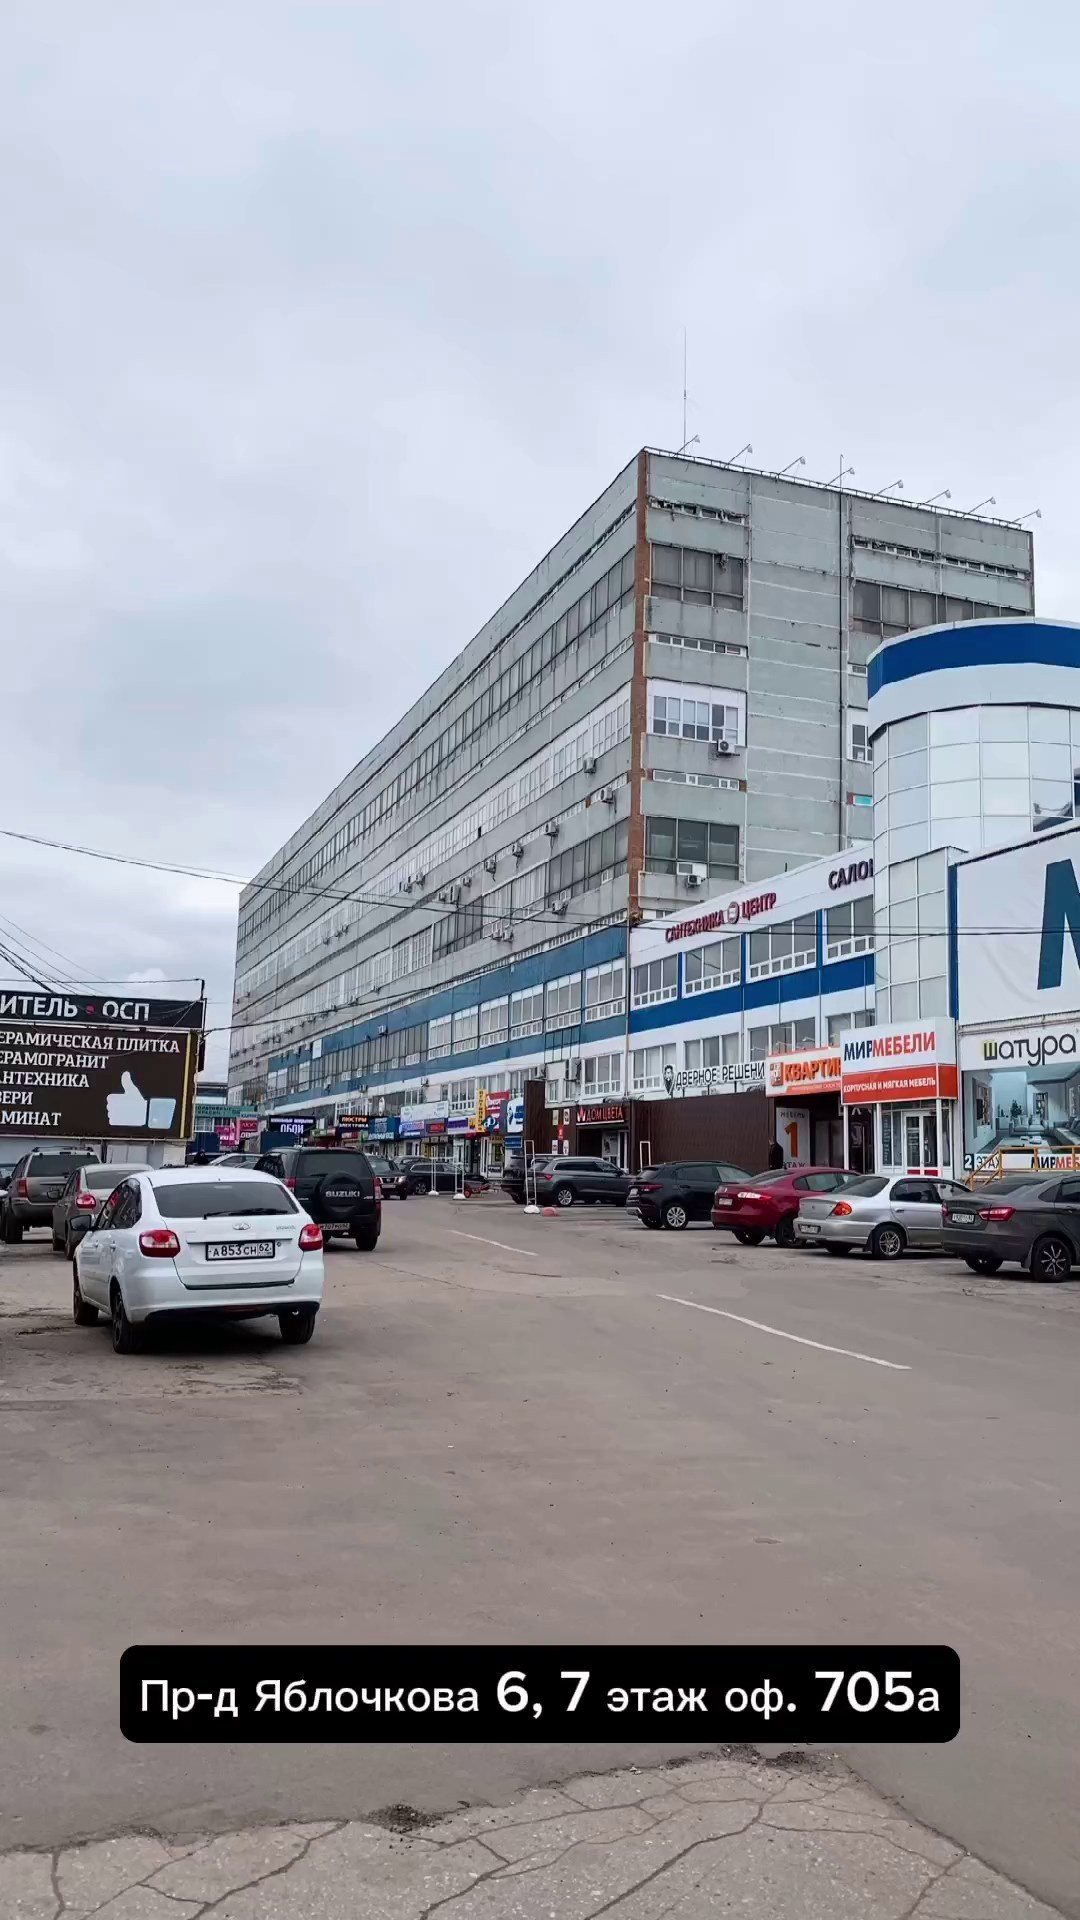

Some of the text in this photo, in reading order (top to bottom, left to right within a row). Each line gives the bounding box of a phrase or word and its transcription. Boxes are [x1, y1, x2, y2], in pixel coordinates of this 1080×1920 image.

[665, 893, 777, 943] САНТЕХНИКА ЦЕНТР
[0, 994, 149, 1021] ИТЕЛЬ ОСП
[116, 1037, 180, 1053] ПЛИТКА
[0, 1071, 90, 1088] НТЕХНИКА
[676, 1068, 717, 1088] ДВЕРНОЕ
[843, 1082, 877, 1093] КОРПУСНАЯ
[878, 1081, 883, 1090] И
[883, 1079, 909, 1090] МЯГКАЯ
[909, 1077, 936, 1087] МЕБЕЛЬ
[0, 1090, 34, 1105] ЕРИ
[586, 1108, 602, 1122] ДОМ
[602, 1105, 623, 1120] ЦВЕТА
[784, 1121, 798, 1158] 1
[964, 1154, 973, 1169] 2
